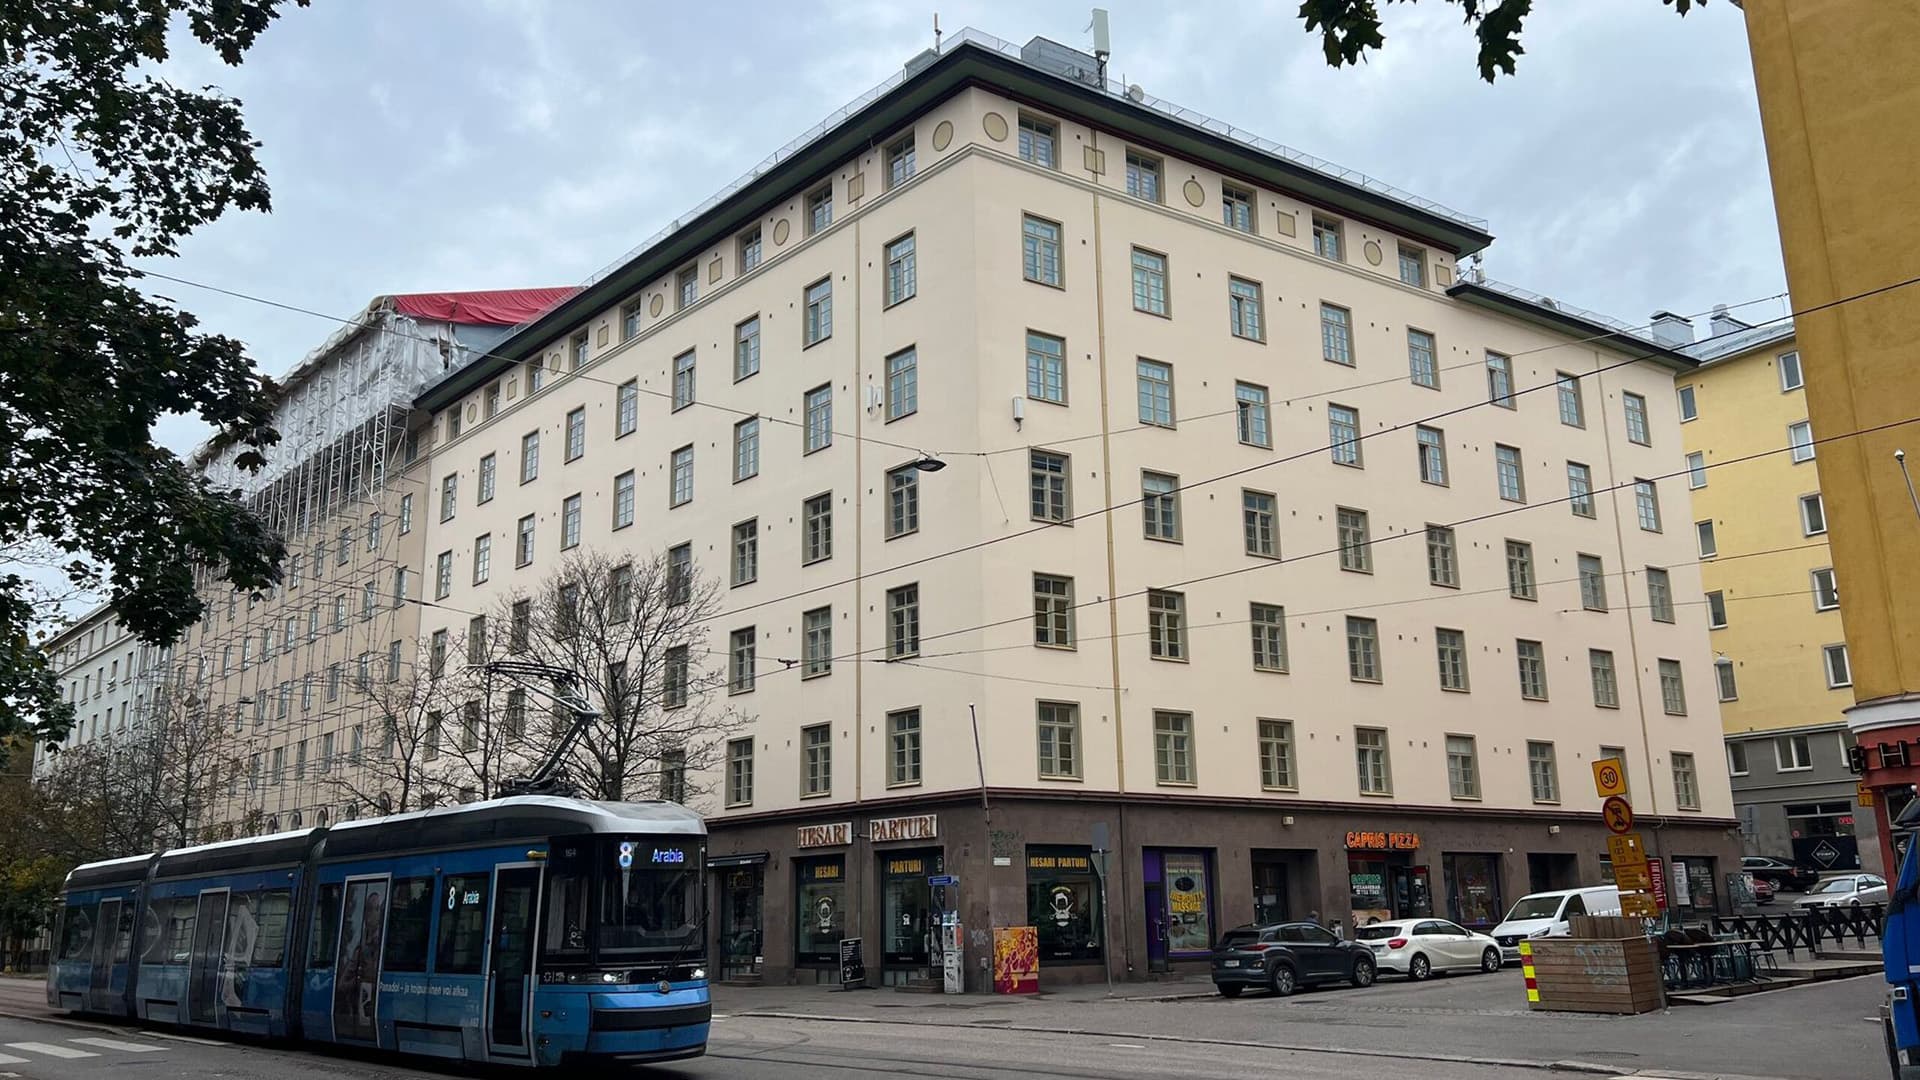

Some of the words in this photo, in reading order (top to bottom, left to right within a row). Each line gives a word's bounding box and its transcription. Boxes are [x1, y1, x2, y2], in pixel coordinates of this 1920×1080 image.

[1602, 770, 1616, 785] 30
[799, 824, 847, 846] HESARI
[871, 815, 935, 840] PARTURI
[1346, 831, 1385, 848] CAPRIS
[1388, 832, 1420, 848] PIZZA
[619, 842, 632, 867] 8
[652, 848, 684, 862] Arabia
[1030, 857, 1055, 868] HESARI
[1058, 857, 1087, 868] PARTURI
[815, 865, 839, 878] HESARI
[890, 859, 922, 873] PARTURI
[448, 886, 456, 909] 8
[463, 890, 480, 904] Arabia
